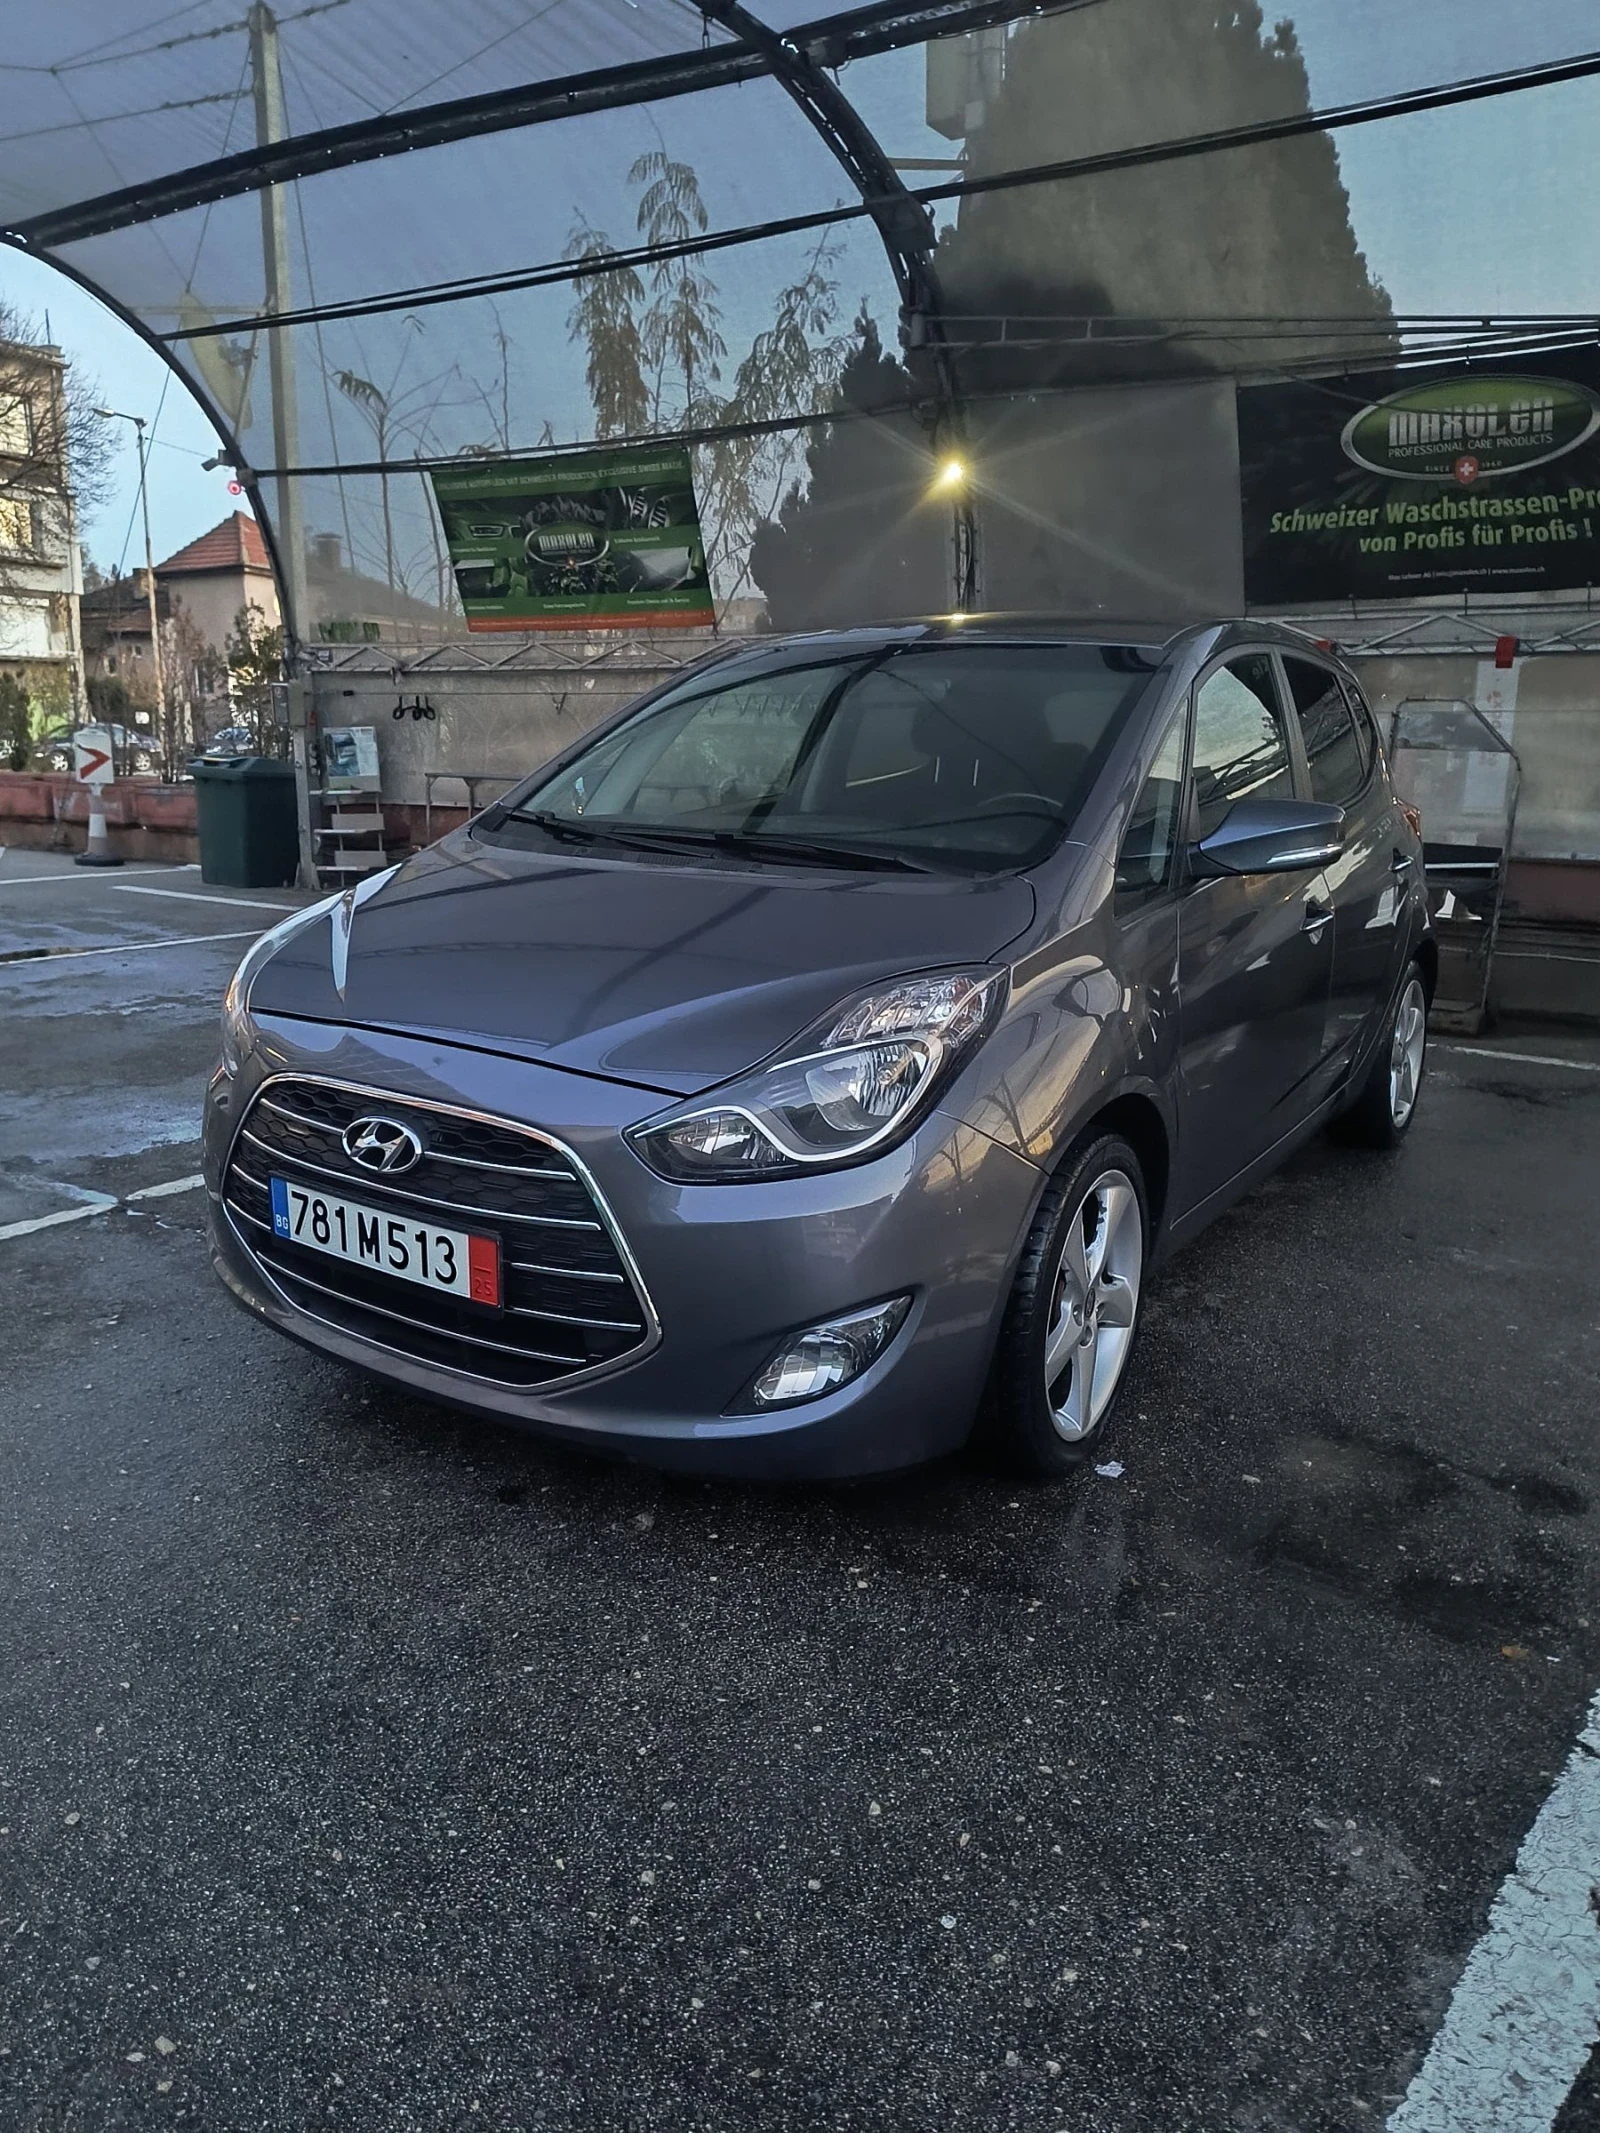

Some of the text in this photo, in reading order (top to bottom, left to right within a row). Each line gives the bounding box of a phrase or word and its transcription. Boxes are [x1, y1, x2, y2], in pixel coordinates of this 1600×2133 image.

[1387, 433, 1554, 459] PROFESSIONAL CARE PRODUCTS
[1270, 487, 1600, 533] Schweizer Waschstrassen-Pr
[1359, 531, 1397, 553] von
[1404, 525, 1465, 551] Profis
[1472, 523, 1504, 546] für
[1511, 518, 1578, 544] Profis
[275, 1213, 289, 1230] BG
